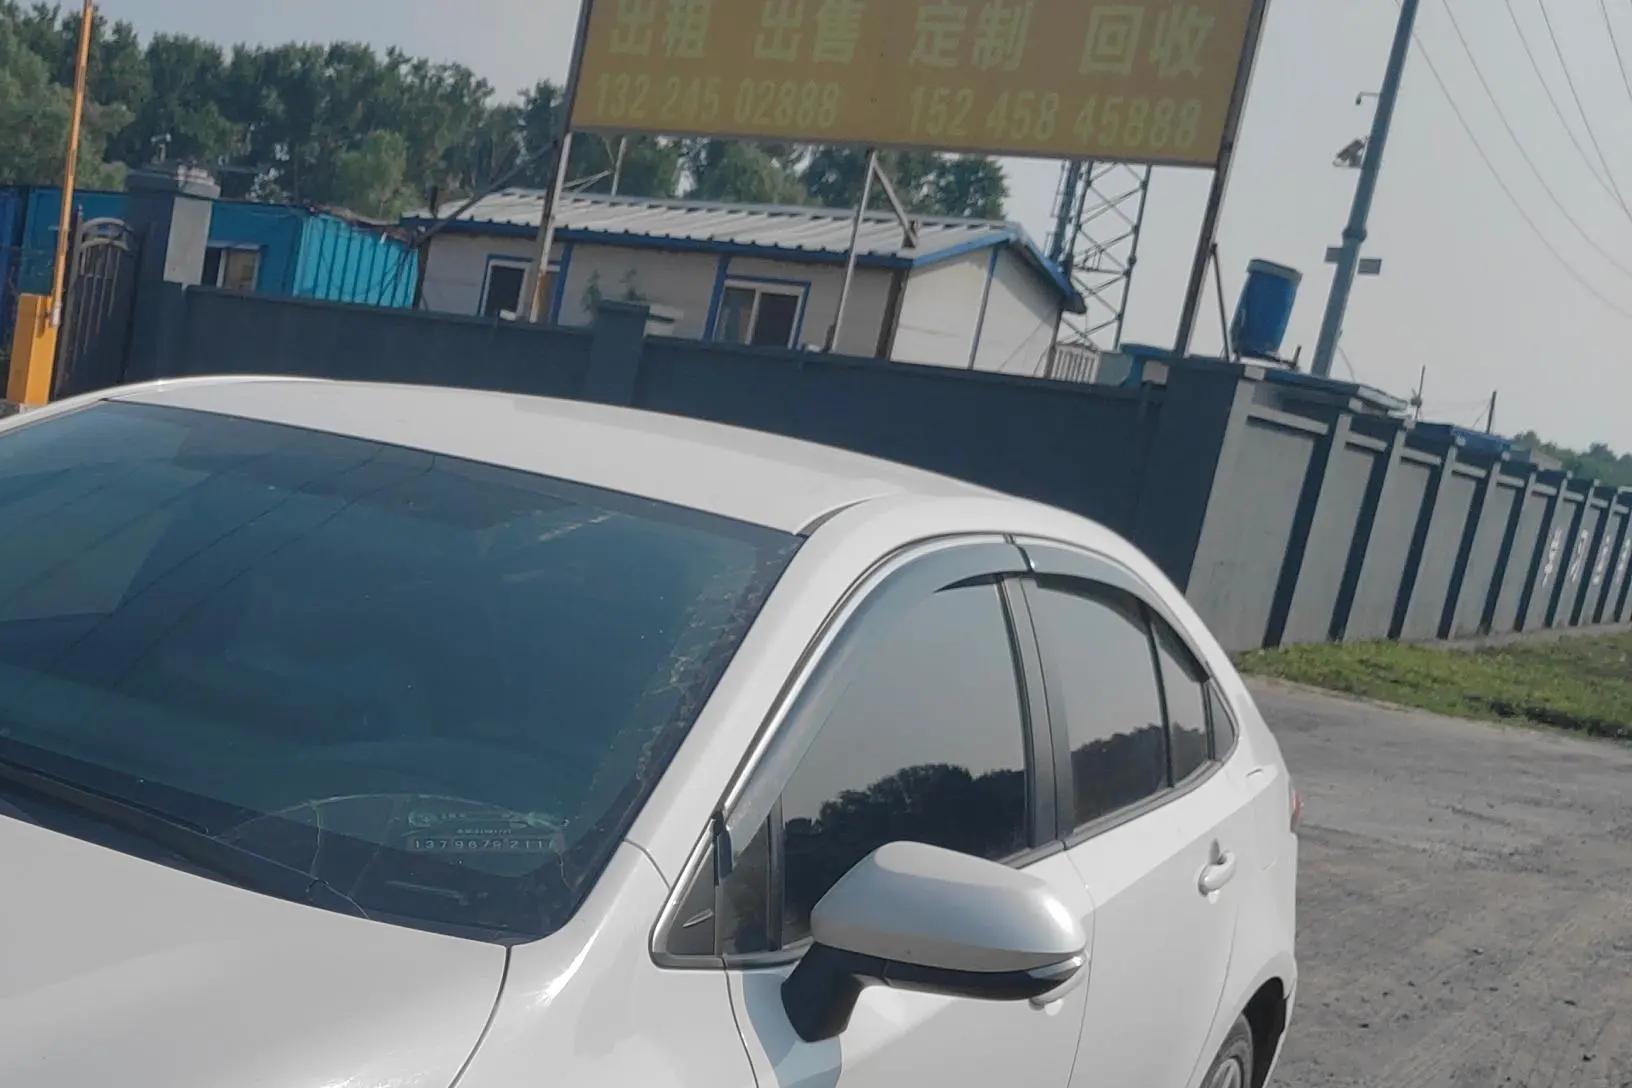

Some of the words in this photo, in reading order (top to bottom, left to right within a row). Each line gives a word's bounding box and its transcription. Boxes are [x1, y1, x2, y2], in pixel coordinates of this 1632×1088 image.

[609, 0, 711, 58] 出租
[753, 0, 866, 63] 出售
[909, 0, 1032, 71] 定制
[1078, 3, 1216, 78] 回收
[596, 72, 651, 119] 132
[734, 77, 841, 128] 02888
[909, 86, 976, 138] 152
[984, 90, 1061, 141] 458
[1072, 97, 1203, 148] 45888
